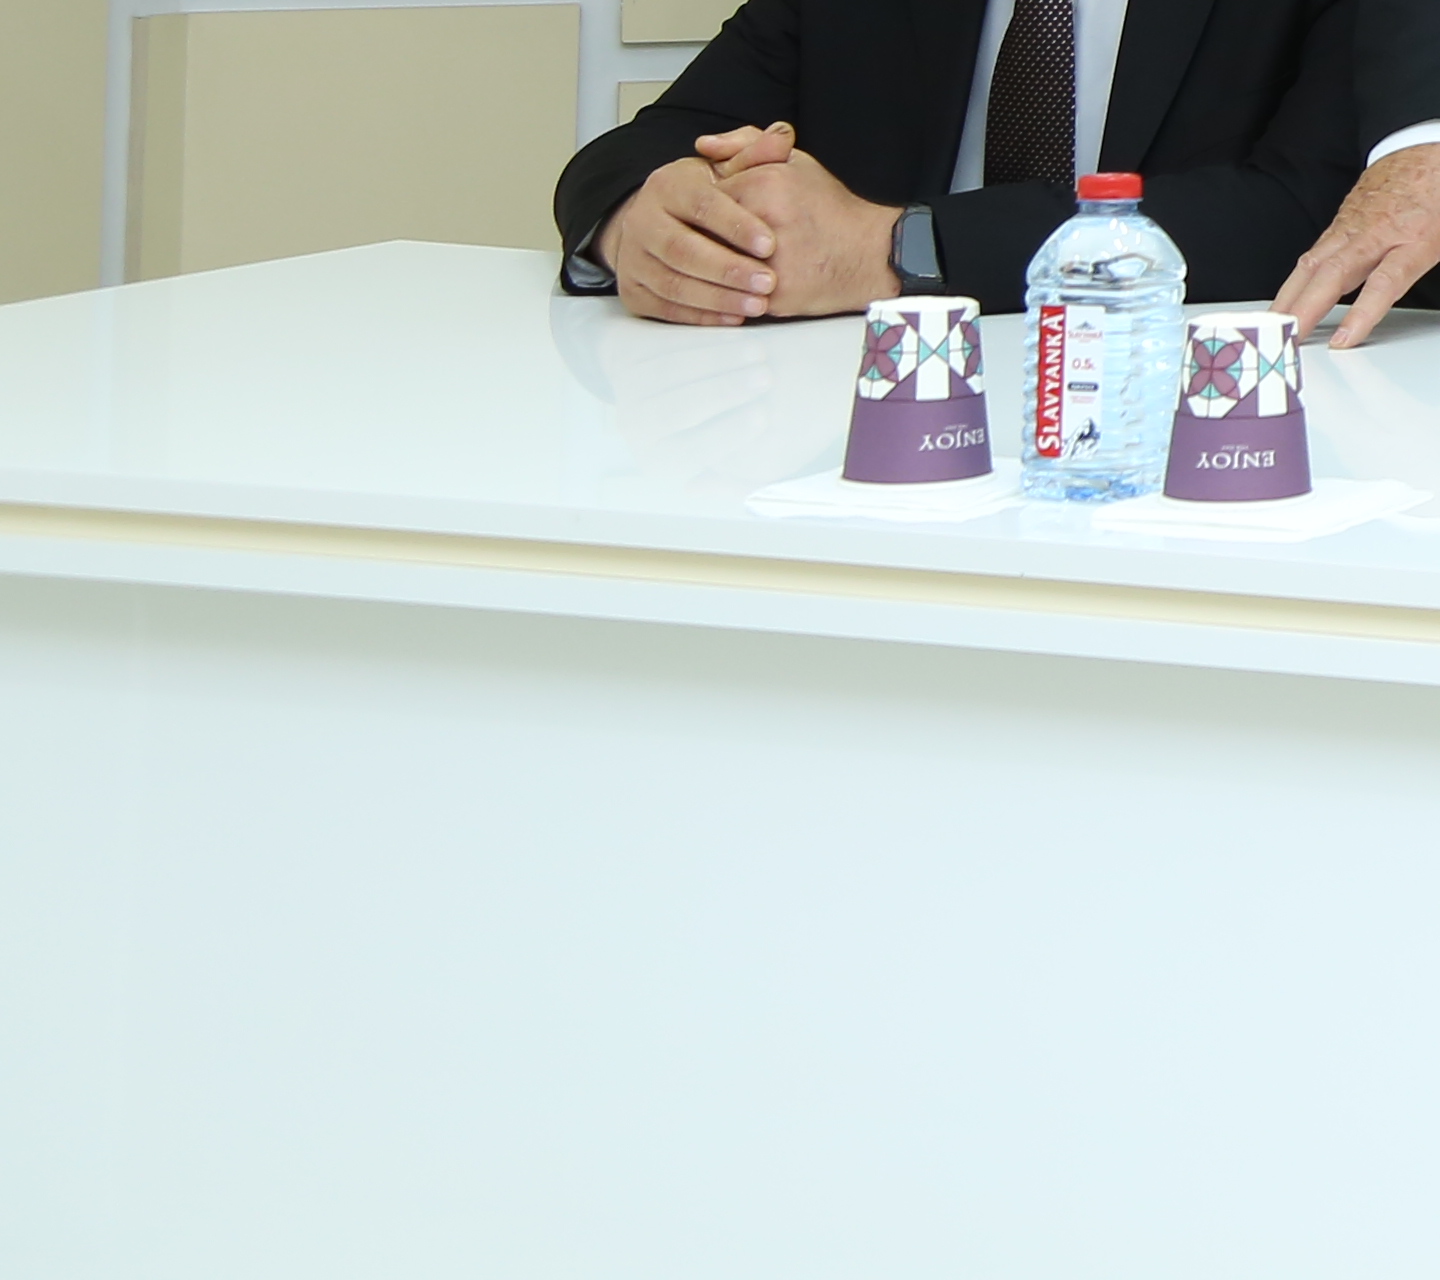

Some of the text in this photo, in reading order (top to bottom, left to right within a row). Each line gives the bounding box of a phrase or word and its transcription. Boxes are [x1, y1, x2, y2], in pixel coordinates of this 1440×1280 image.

[1038, 313, 1065, 450] SLAVYANKA
[919, 428, 985, 452] ENJOY
[1195, 449, 1275, 470] ENJOY
